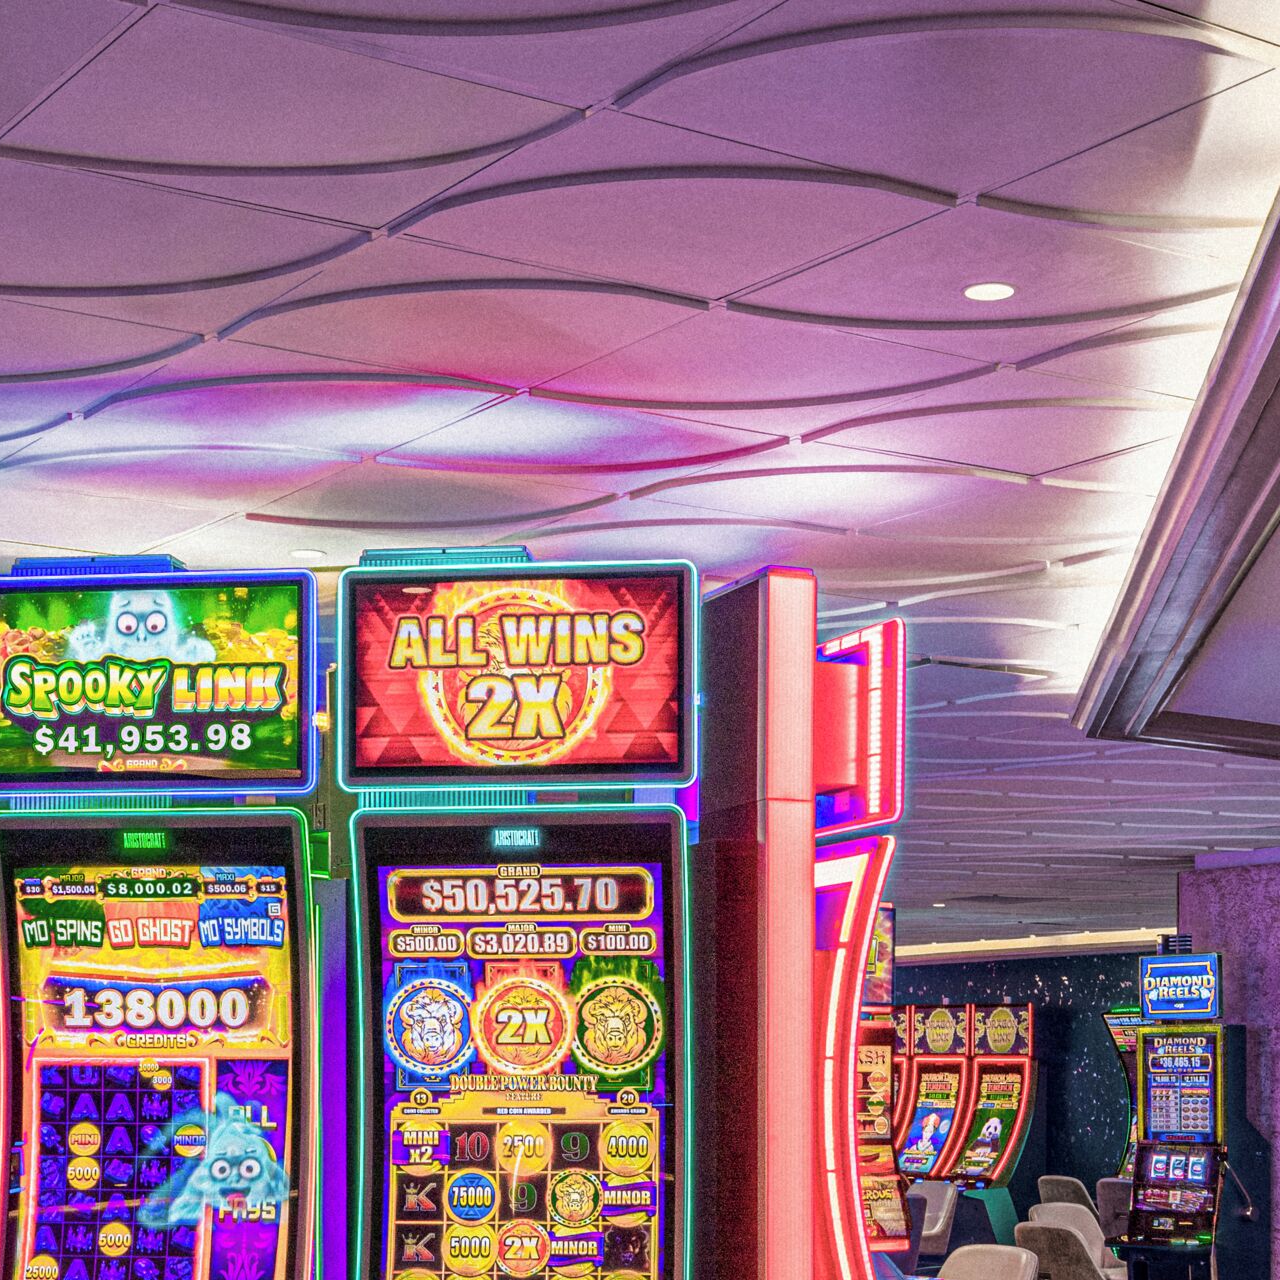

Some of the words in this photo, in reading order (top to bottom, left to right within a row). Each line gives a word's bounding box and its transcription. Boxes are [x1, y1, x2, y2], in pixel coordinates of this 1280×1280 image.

[389, 616, 487, 668] ALL
[501, 611, 645, 666] WINS
[6, 659, 166, 720] SPOOKY
[172, 662, 282, 714] LINK
[467, 673, 564, 740] 2X
[34, 723, 252, 757] $41,953.98
[126, 758, 158, 768] GRAND
[124, 833, 161, 849] ARISTOCRAT
[495, 830, 535, 846] ARISTOCRAT
[59, 874, 85, 882] MAJOR
[131, 868, 166, 878] GRAND
[216, 873, 235, 881] MAXI
[500, 866, 538, 876] GRAND
[422, 878, 619, 914] $50,525.70
[56, 920, 102, 943] SPINS
[110, 920, 133, 943] GO
[138, 920, 194, 943] GHOST
[223, 919, 284, 943] SYMBOLS
[414, 926, 439, 934] MINOR
[508, 924, 535, 932] MAJOR
[609, 924, 626, 932] MINI
[396, 935, 457, 952] $500.00
[474, 934, 568, 954] $3,020.89
[588, 935, 649, 950] $100.00
[1144, 976, 1215, 992] DIAMOND
[1158, 986, 1200, 998] REELS
[64, 988, 249, 1028] 138000
[496, 1008, 552, 1044] 2X
[126, 1035, 188, 1048] CREDITS
[1154, 1037, 1206, 1047] DIAMOND
[1160, 1057, 1200, 1068] $36,465.15
[451, 1074, 500, 1091] DOUBLE
[501, 1074, 548, 1091] POWER
[551, 1074, 597, 1091] BOUNTY
[416, 1094, 427, 1103] 13
[507, 1093, 542, 1101] FEATURE
[621, 1094, 634, 1104] 20
[70, 1134, 99, 1146] MINI
[174, 1135, 206, 1145] MINOR
[404, 1131, 439, 1145] MINI
[455, 1132, 490, 1161] 10
[503, 1135, 544, 1158] 2500
[561, 1132, 589, 1161] 9
[607, 1135, 647, 1157] 4000
[67, 1166, 100, 1181] 5000
[99, 1232, 131, 1248] 5000
[403, 1233, 435, 1261] K
[450, 1236, 491, 1258] 5000
[504, 1237, 538, 1260] 2X
[551, 1241, 597, 1256] MINOR
[26, 1265, 59, 1279] 25000
